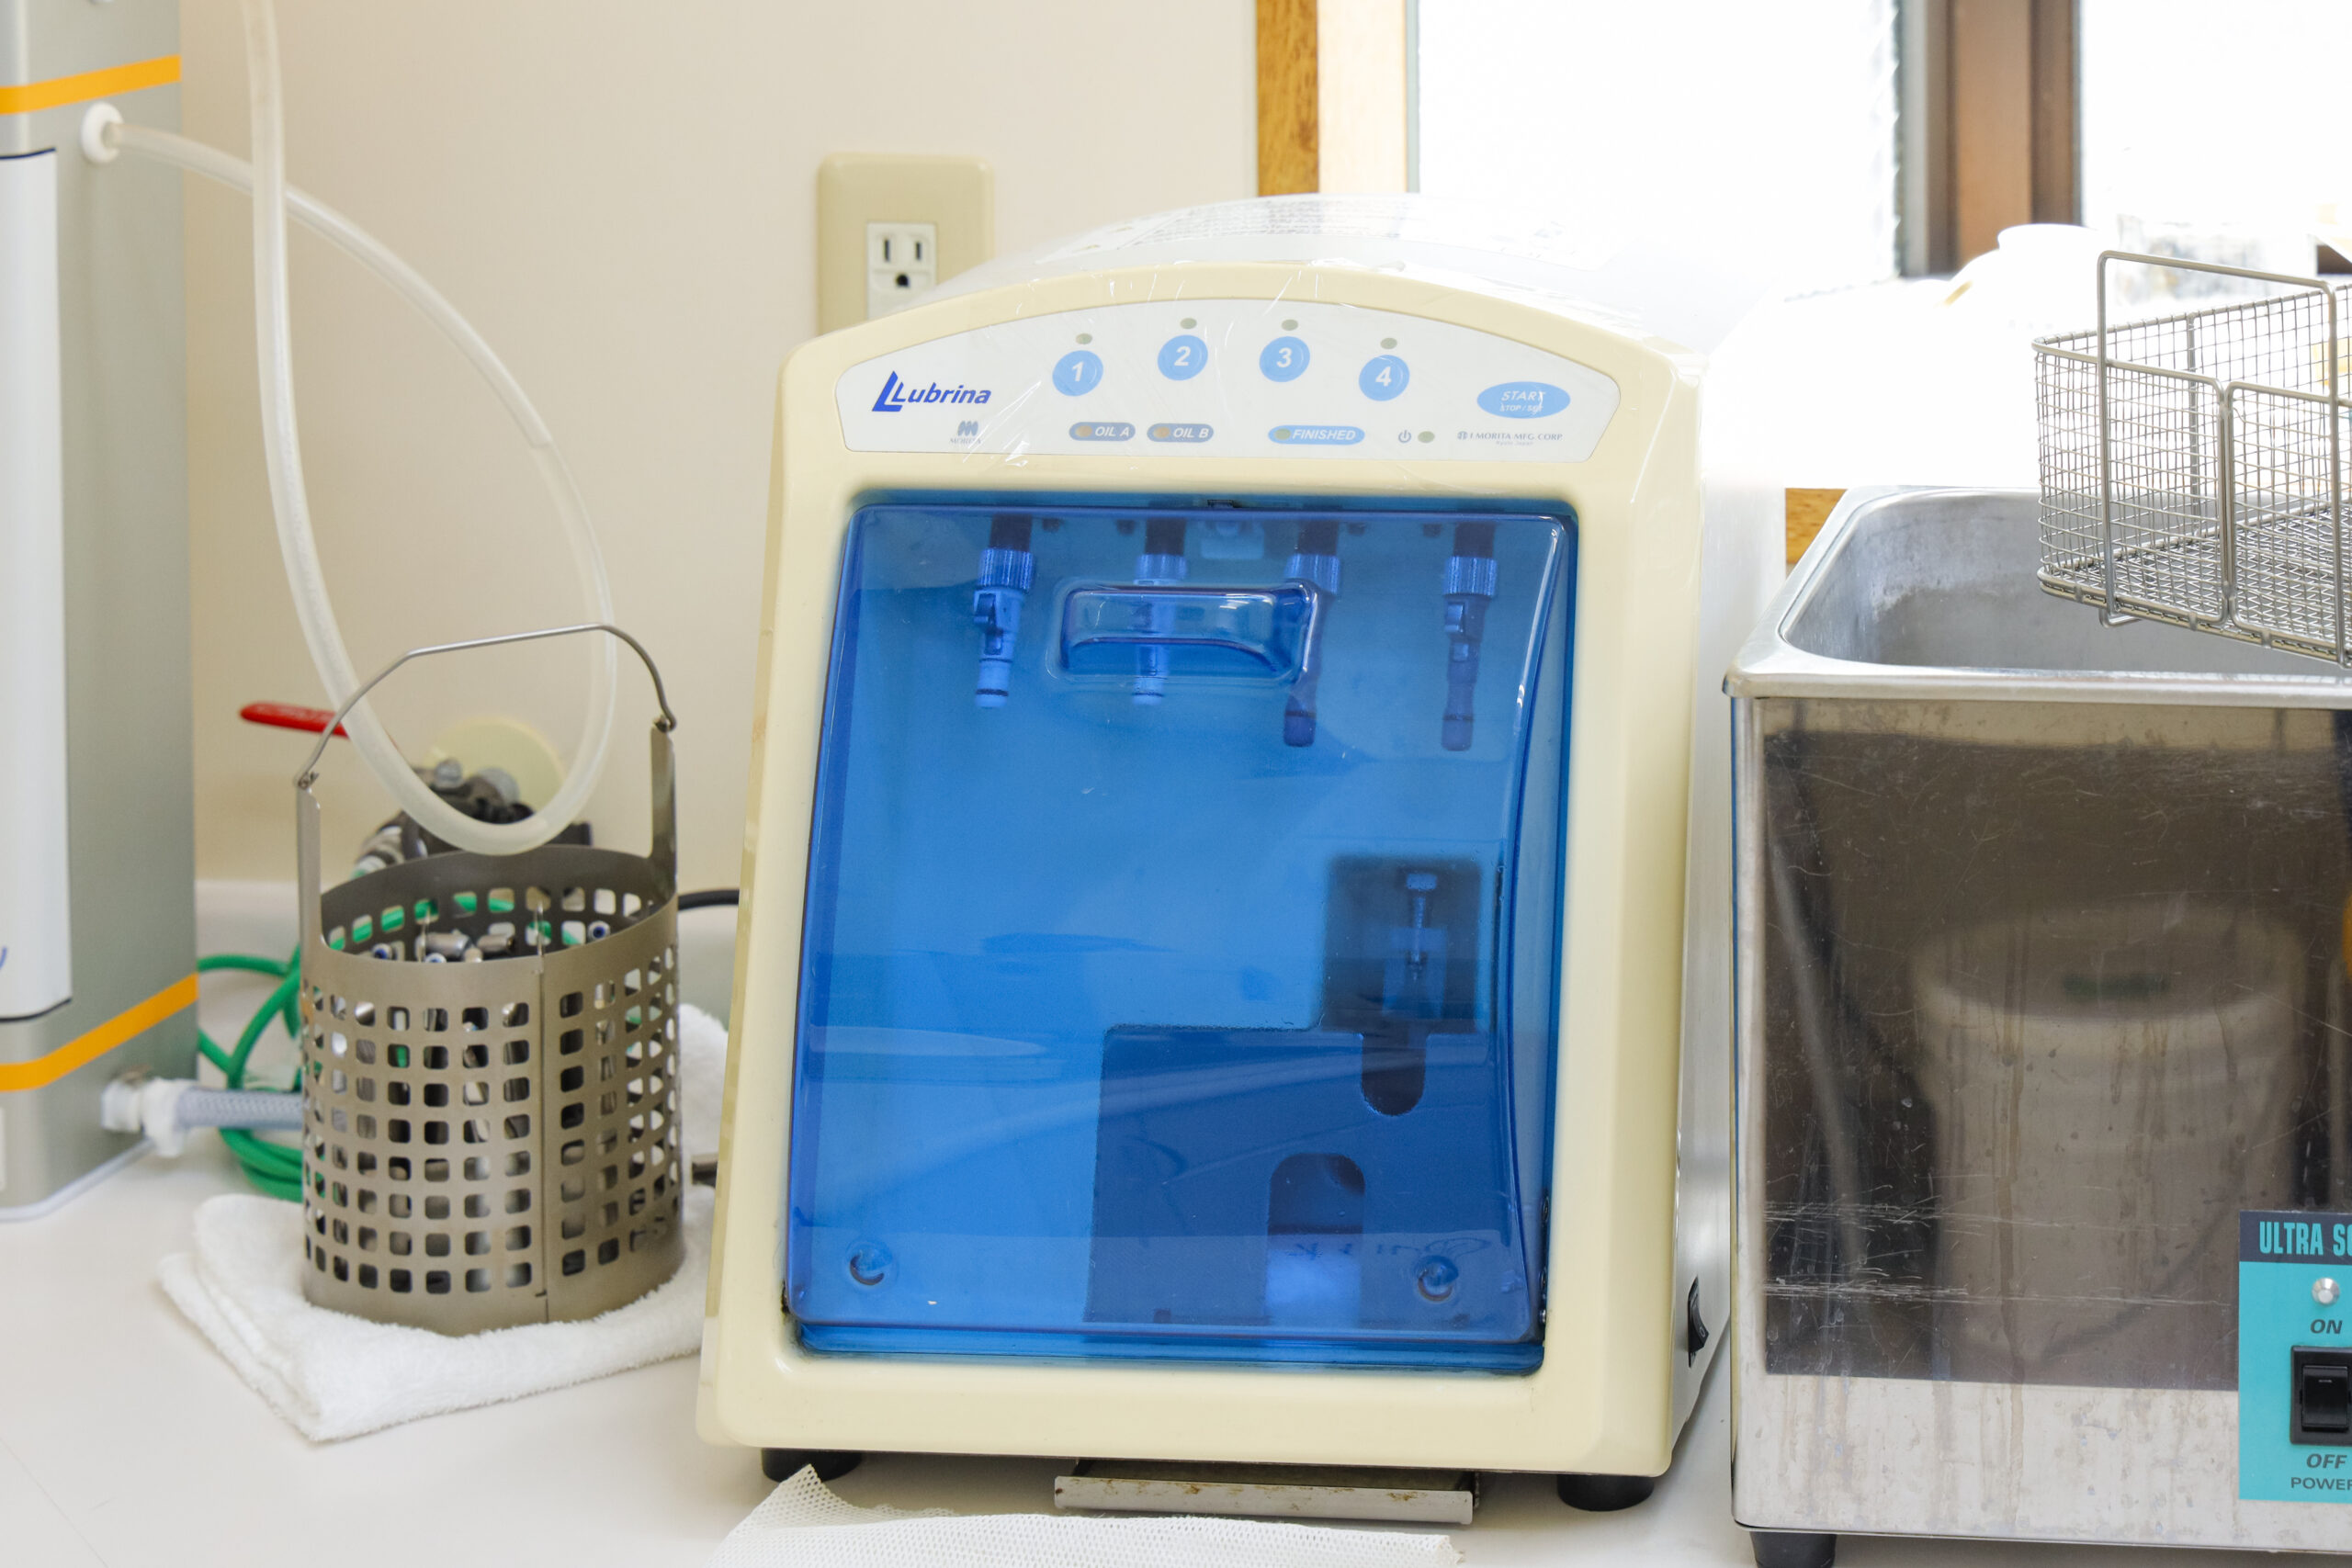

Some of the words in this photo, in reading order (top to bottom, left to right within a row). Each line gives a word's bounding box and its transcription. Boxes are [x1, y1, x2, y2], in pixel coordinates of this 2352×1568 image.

[1173, 345, 1191, 367] 2
[1276, 347, 1293, 367] 3
[1072, 361, 1084, 381] 1
[1375, 366, 1392, 387] 4
[1094, 426, 1116, 437] OIL
[1119, 426, 1131, 437] A
[1172, 427, 1194, 438] OIL
[1199, 428, 1210, 438] B
[1292, 429, 1357, 441] FINISHED
[2259, 1221, 2324, 1256] ULTRA
[2310, 1319, 2343, 1335] ON
[2306, 1453, 2347, 1469] OFF
